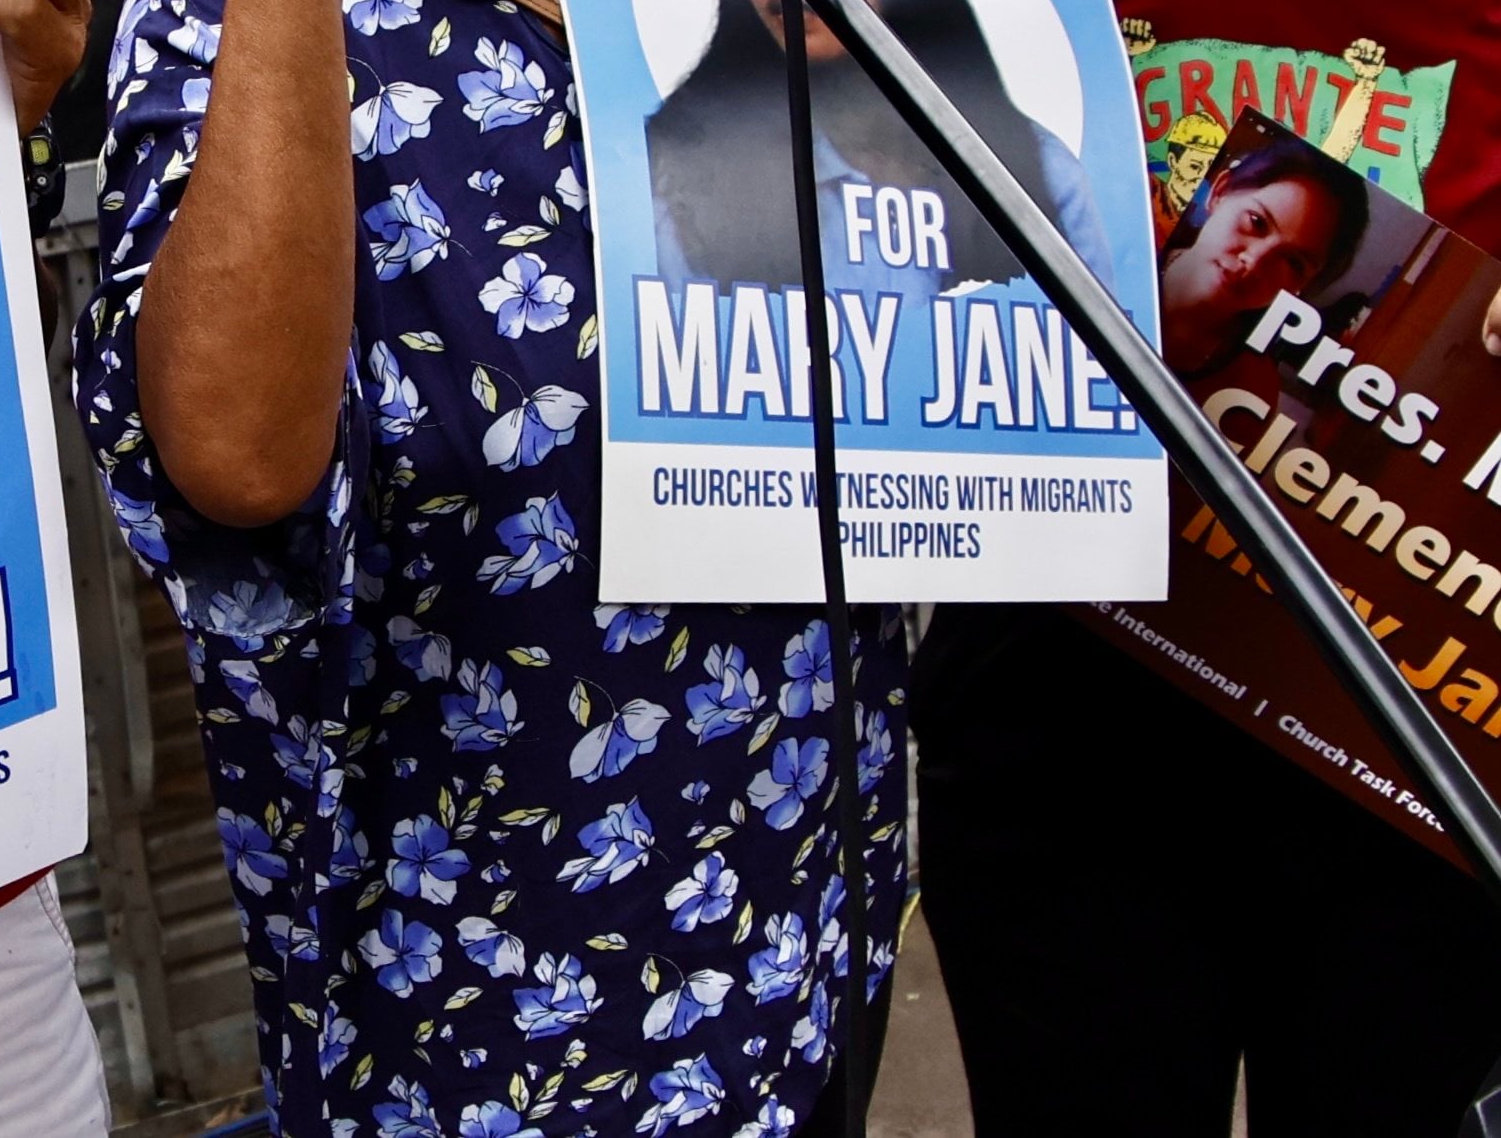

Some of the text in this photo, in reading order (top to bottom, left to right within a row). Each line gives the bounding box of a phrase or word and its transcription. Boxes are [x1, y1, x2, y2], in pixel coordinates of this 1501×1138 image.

[842, 182, 952, 271] FOR
[633, 275, 902, 426] MARY
[1245, 288, 1446, 464] Pres.
[653, 467, 1133, 514] CHURCHES WTNESSING WITH MIGRANTS
[838, 522, 981, 559] PHILIPPINES
[1202, 388, 1501, 632] Clemen
[1113, 607, 1247, 701] International
[1278, 714, 1349, 767] Church
[1351, 759, 1397, 798] Task
[1395, 790, 1445, 832] Forc
